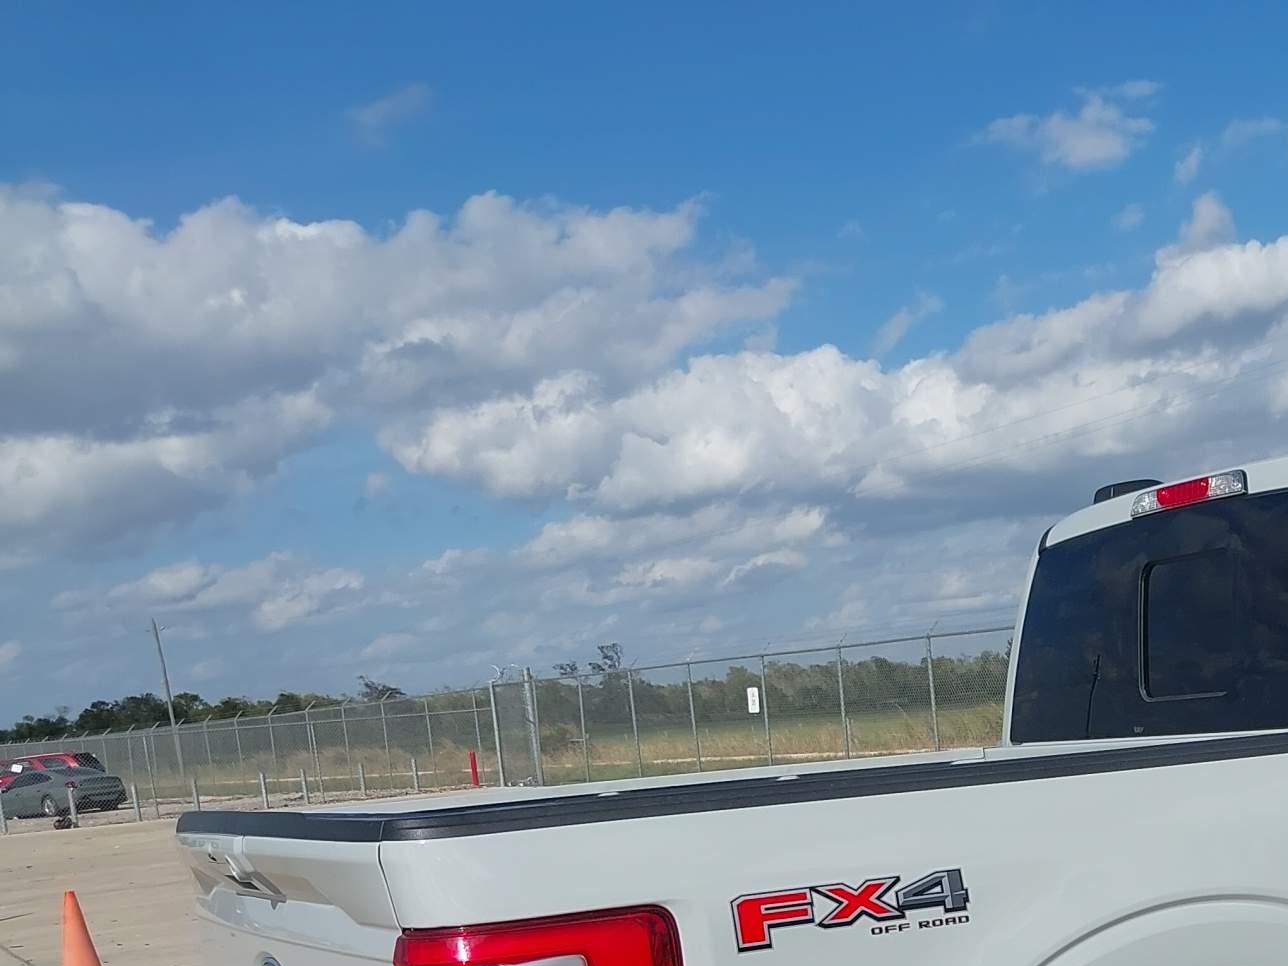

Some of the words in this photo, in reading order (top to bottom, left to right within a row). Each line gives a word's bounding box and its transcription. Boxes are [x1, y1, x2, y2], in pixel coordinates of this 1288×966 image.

[730, 868, 970, 953] FX4
[870, 922, 910, 936] OFF
[917, 914, 970, 930] ROAD
